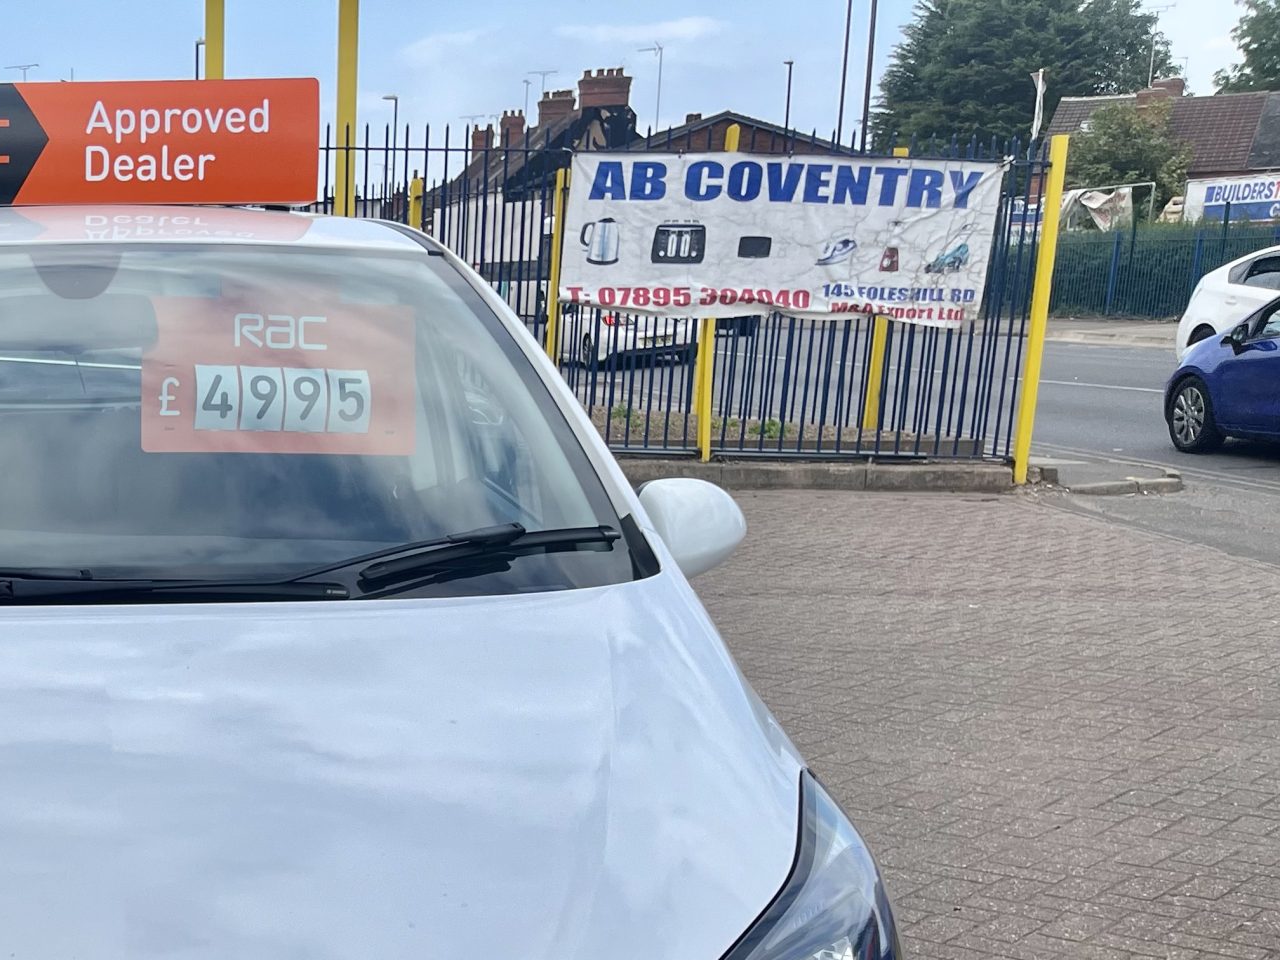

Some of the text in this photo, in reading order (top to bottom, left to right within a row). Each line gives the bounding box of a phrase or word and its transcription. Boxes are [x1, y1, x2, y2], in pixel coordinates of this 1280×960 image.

[85, 98, 271, 143] Approved
[85, 145, 216, 182] Dealer
[589, 160, 985, 209] AB COVENTRY
[598, 287, 692, 307] 07895
[822, 284, 976, 303] 145 FOLESHILL RD
[831, 301, 874, 315] M&A
[937, 306, 965, 321] Ltd
[201, 373, 365, 422] 4995
